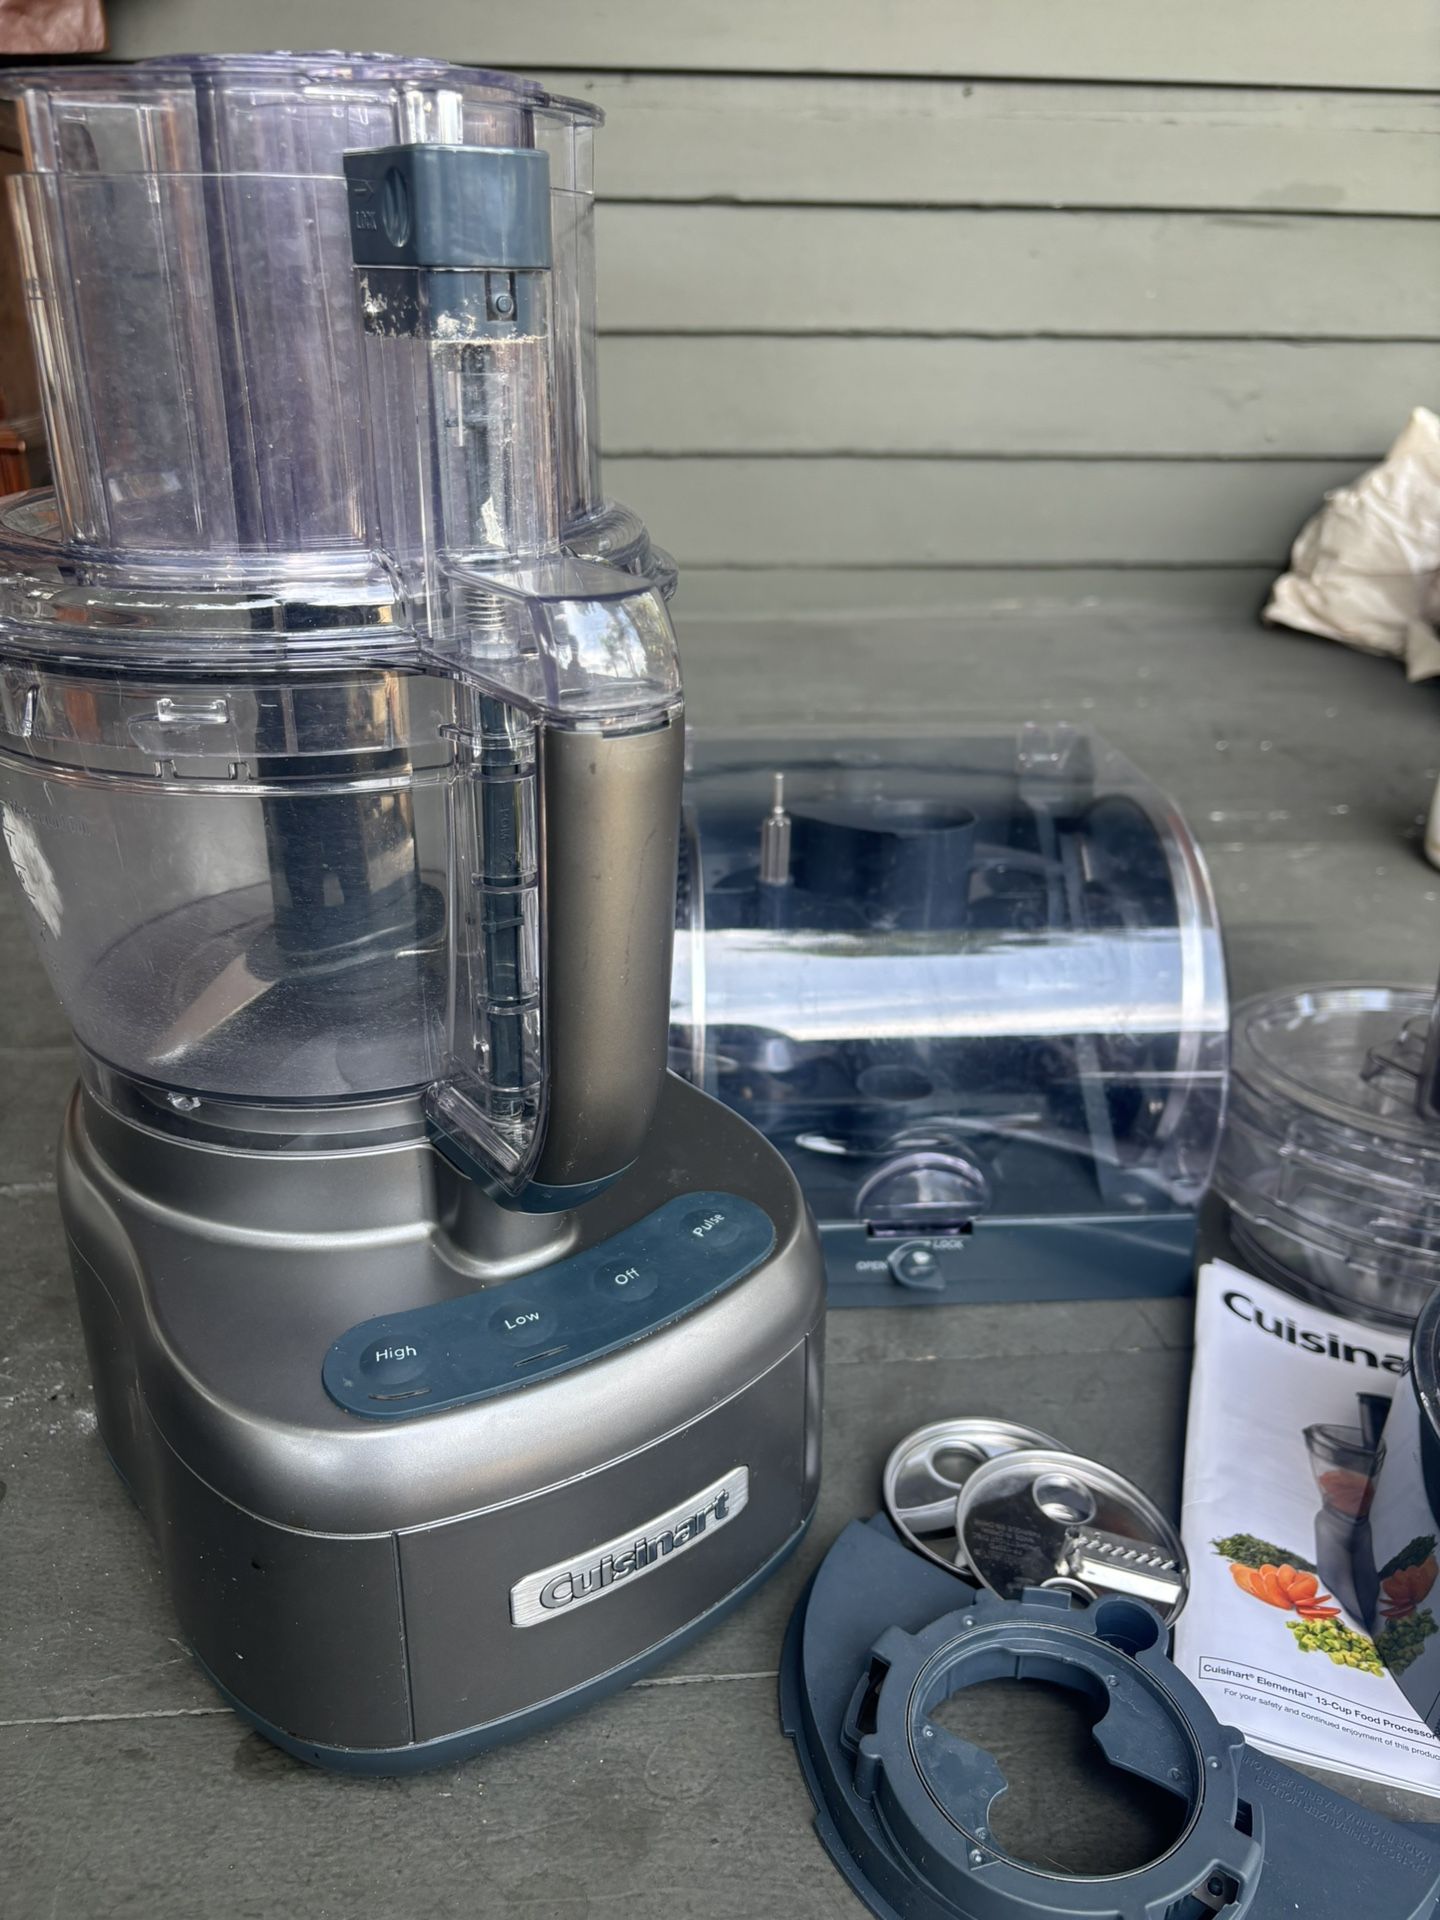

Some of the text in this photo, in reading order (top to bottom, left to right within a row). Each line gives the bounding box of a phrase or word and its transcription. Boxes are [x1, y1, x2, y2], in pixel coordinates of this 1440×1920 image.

[693, 1211, 726, 1237] Pulse
[932, 1239, 964, 1249] LOCK
[615, 1267, 640, 1286] Off
[856, 1260, 888, 1271] OPEN
[504, 1310, 540, 1331] Low
[1223, 1291, 1403, 1373] Cuisina
[375, 1344, 418, 1364] High
[538, 1488, 731, 1611] Cuisinart
[1223, 1688, 1440, 1760] For your safety and continued enjoyment of this produc
[1316, 1696, 1352, 1716] 13-Cup
[1354, 1710, 1381, 1725] Food
[1383, 1719, 1436, 1739] Processor
